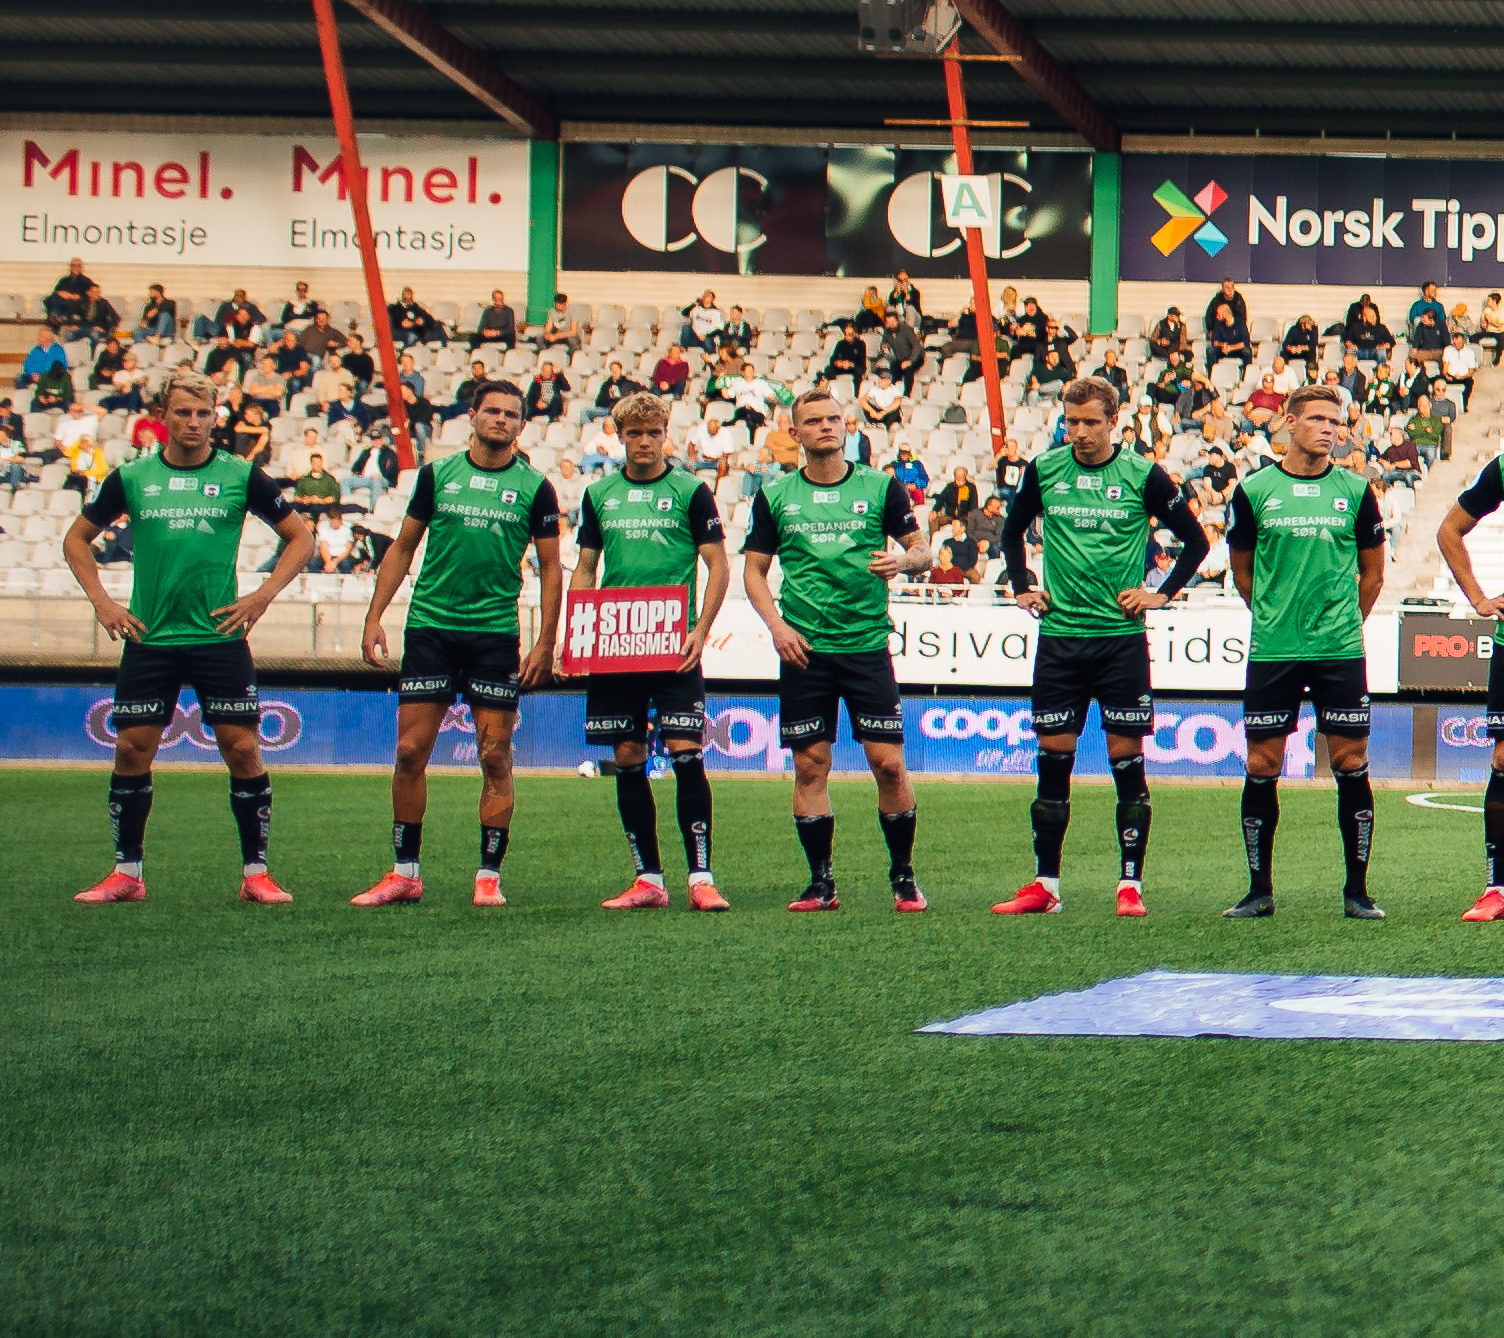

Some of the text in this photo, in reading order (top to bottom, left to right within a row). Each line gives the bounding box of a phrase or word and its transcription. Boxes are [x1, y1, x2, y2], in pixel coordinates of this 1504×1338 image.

[22, 139, 234, 200] Minel.
[951, 182, 987, 219] A
[1248, 194, 1405, 248] Norsk
[20, 212, 209, 255] Elmontasje
[139, 508, 228, 520] SPAREBANKEN
[437, 502, 521, 523] SPAREBANKEN
[1047, 505, 1129, 520] SPAREBANKEN
[1262, 515, 1346, 529] SPAREBANKEN
[598, 631, 682, 657] RASISMEN
[401, 679, 448, 692] MASIV
[471, 682, 516, 698] MASIV
[211, 701, 259, 713] MASIV
[1103, 709, 1150, 721] MASIV
[584, 718, 628, 731] MASIV
